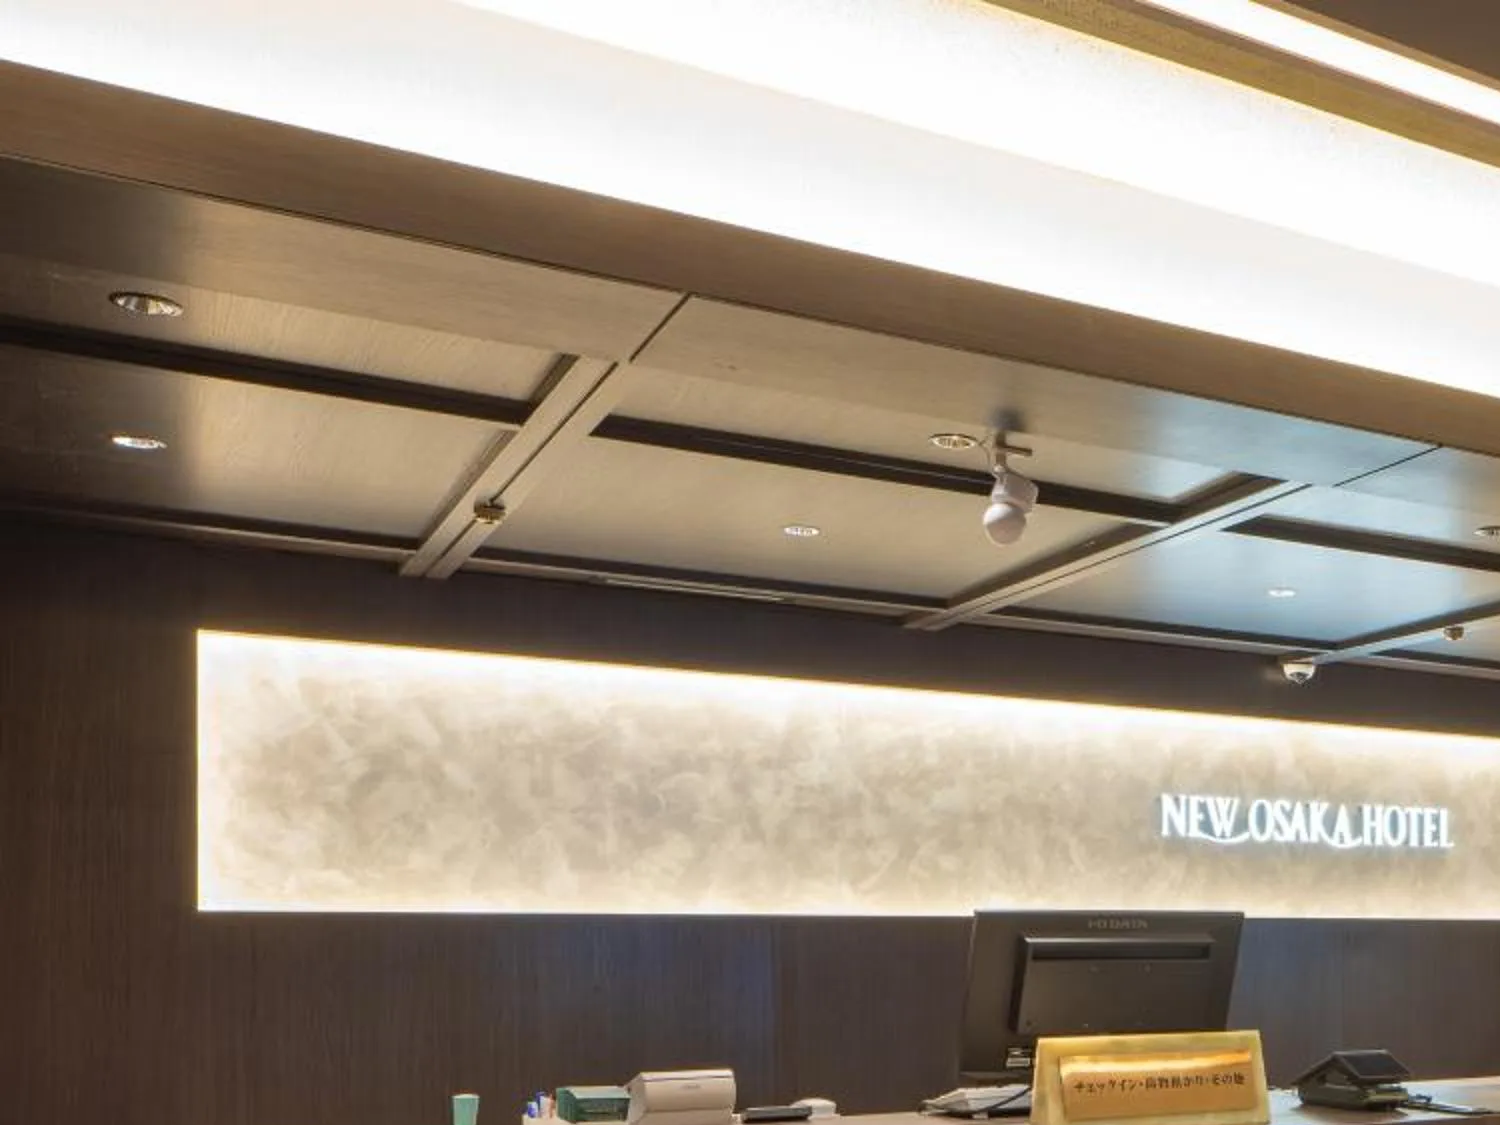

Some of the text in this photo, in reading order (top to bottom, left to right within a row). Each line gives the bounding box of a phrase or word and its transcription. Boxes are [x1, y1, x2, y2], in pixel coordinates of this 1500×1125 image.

[1160, 793, 1453, 849] NEW OSAKA HOTEL
